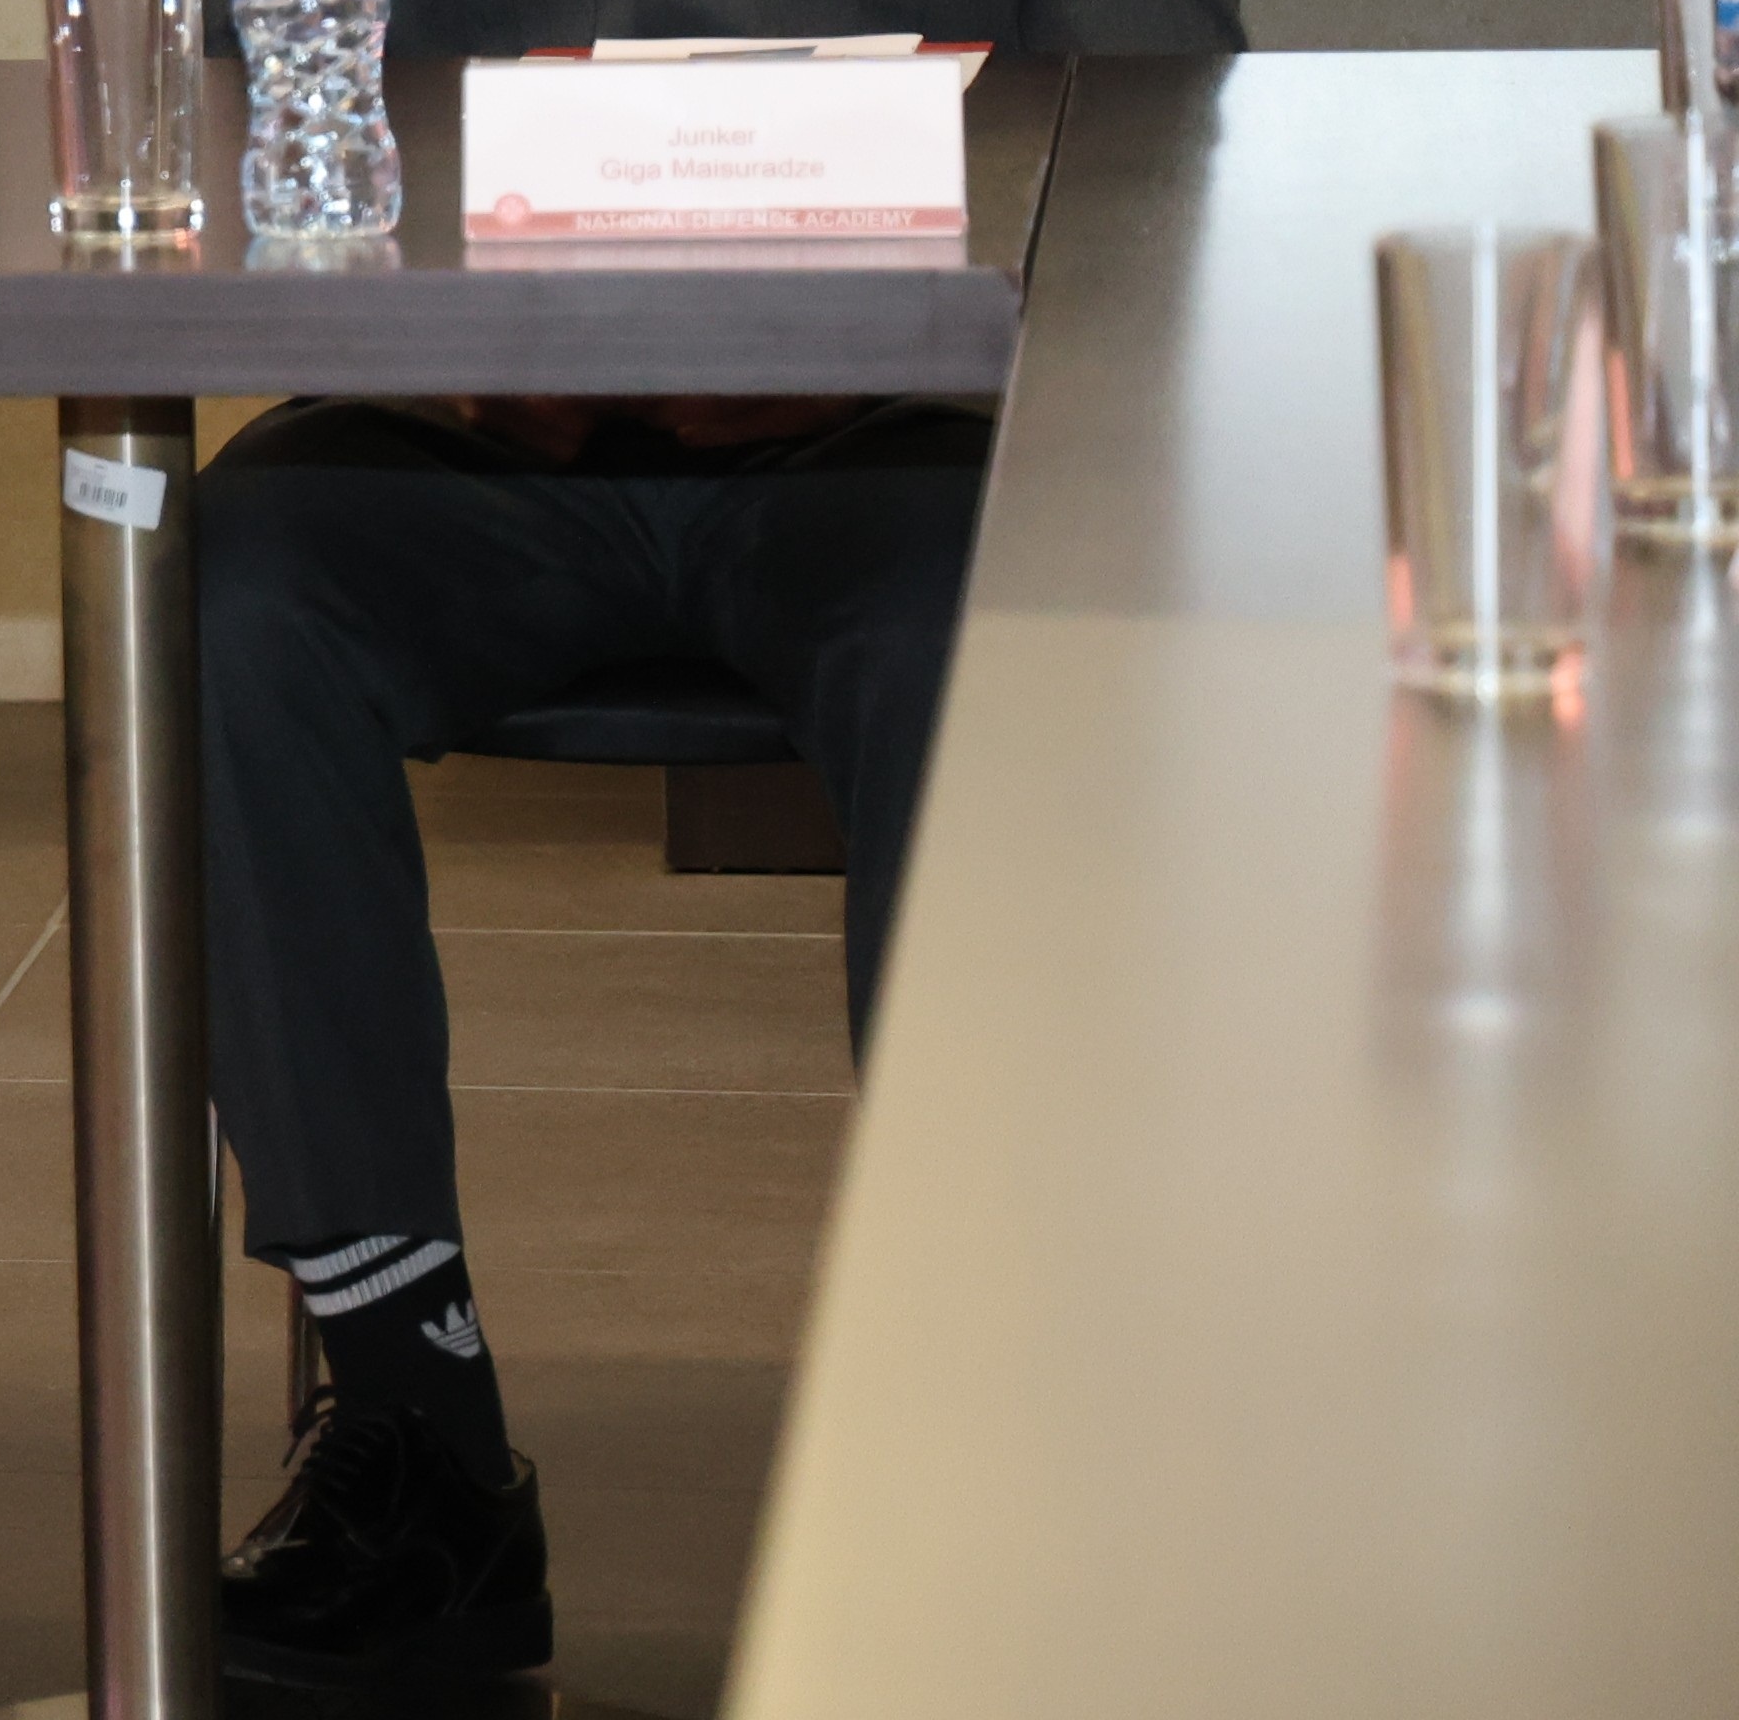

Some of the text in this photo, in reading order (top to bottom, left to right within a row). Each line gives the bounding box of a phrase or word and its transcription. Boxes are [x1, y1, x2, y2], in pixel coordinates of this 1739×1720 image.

[668, 126, 756, 147] Junker
[600, 157, 825, 185] Giga Maisuradze
[577, 211, 685, 230] NATIONAL
[805, 209, 916, 228] ACADEMY
